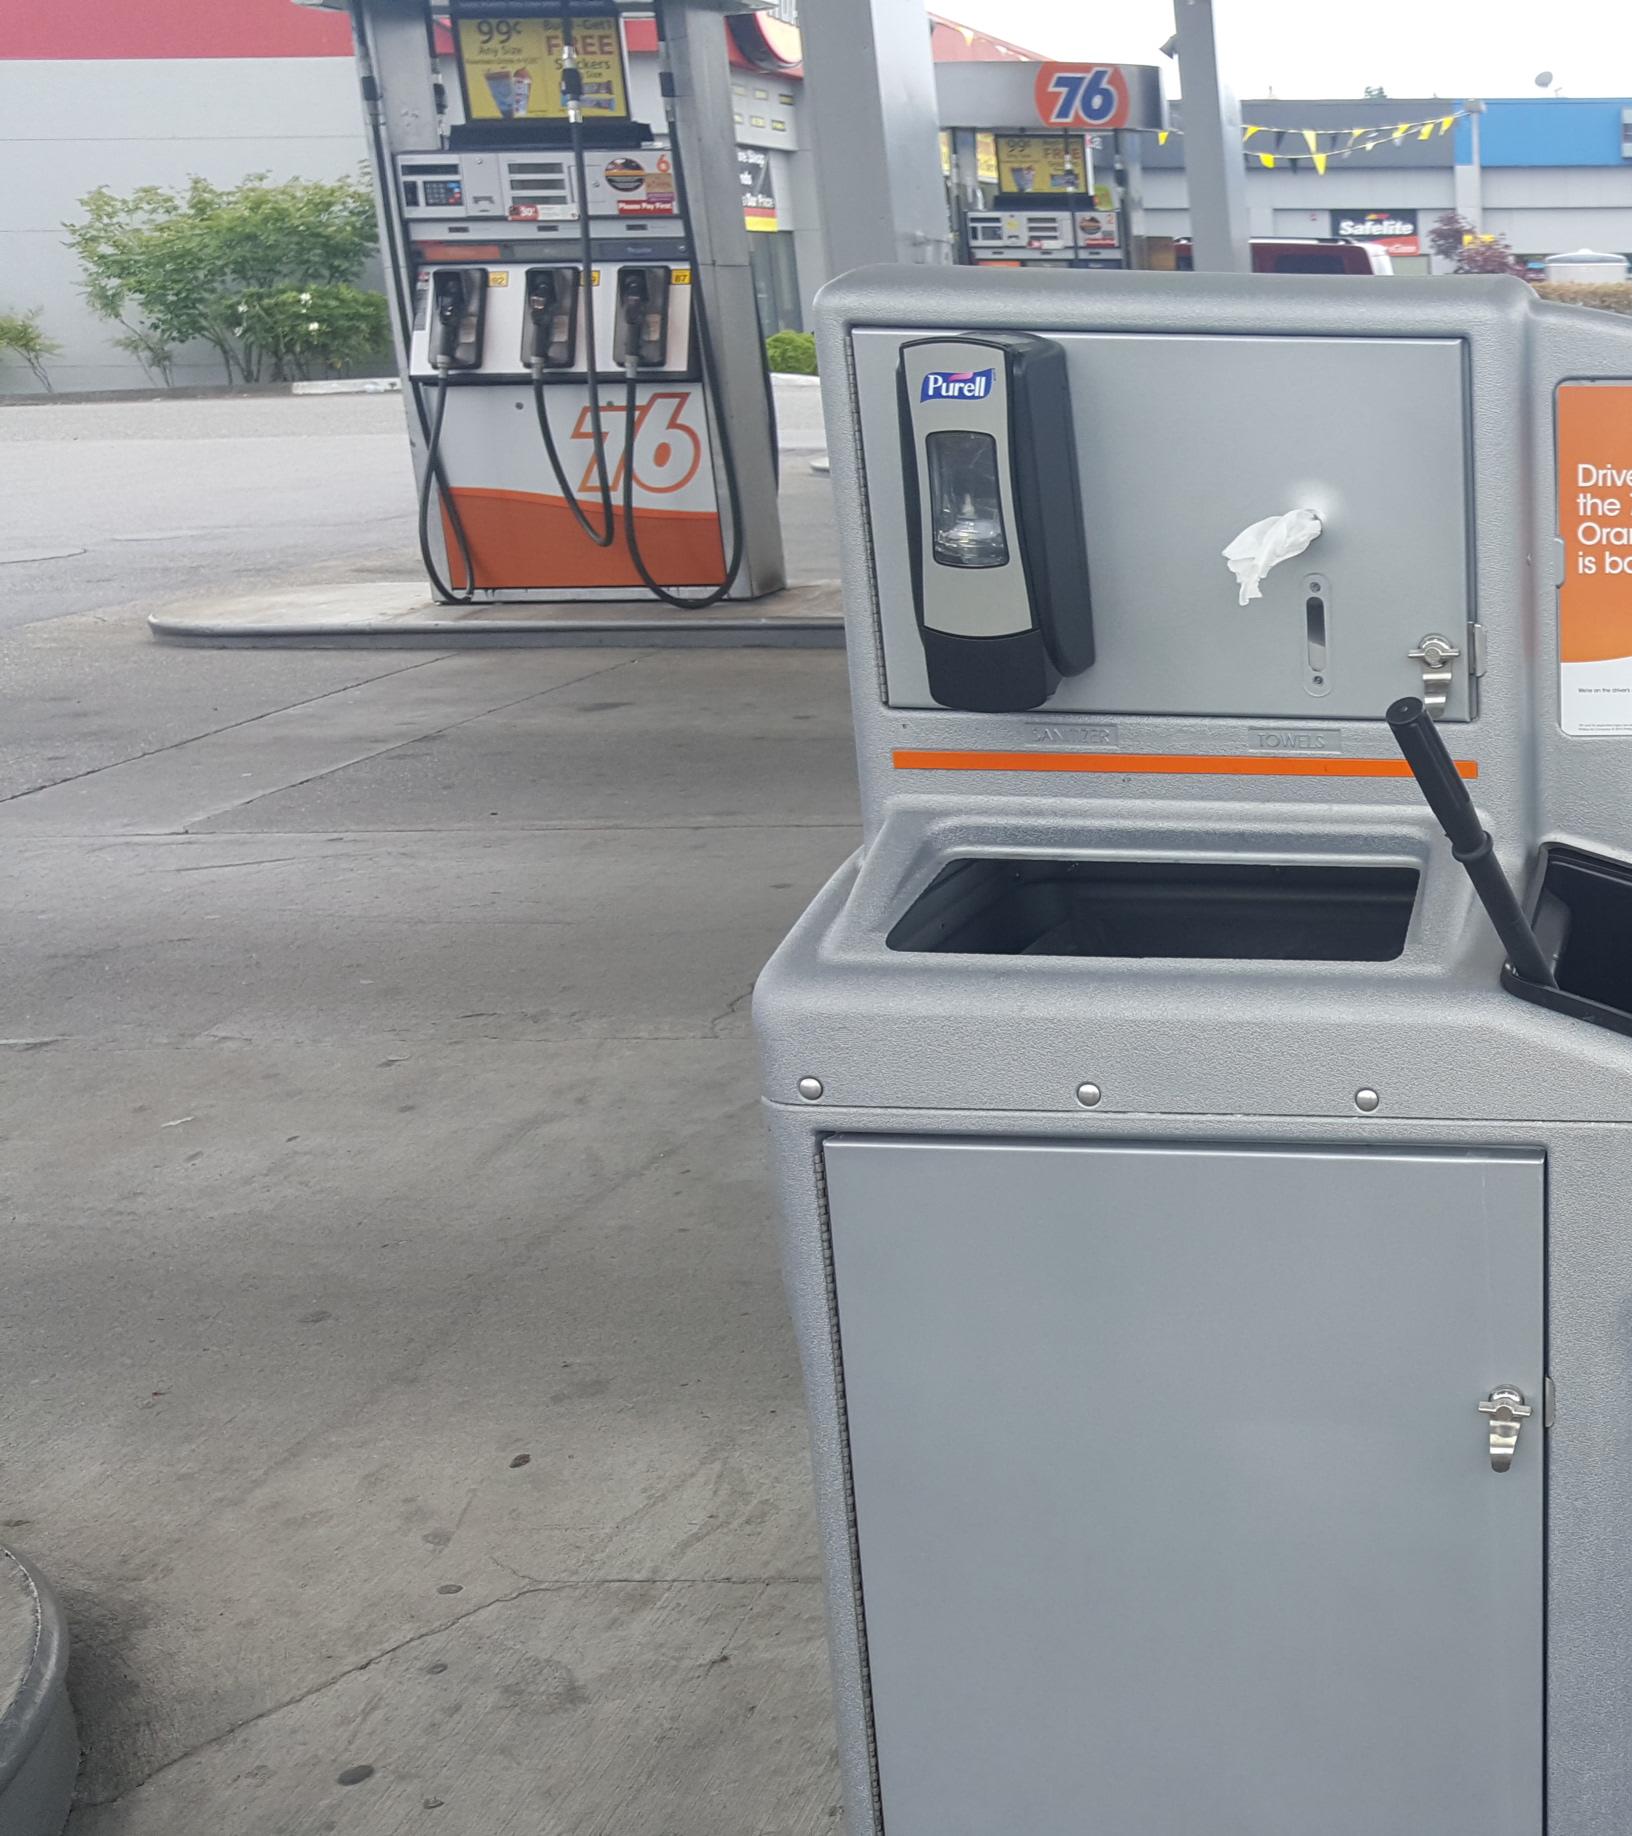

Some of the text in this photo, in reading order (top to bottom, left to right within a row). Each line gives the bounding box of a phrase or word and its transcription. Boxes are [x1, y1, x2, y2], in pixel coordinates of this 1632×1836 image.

[1047, 67, 1116, 125] 76
[656, 153, 671, 173] 6
[1339, 219, 1414, 235] Safelite
[927, 374, 987, 397] Purell
[570, 391, 701, 494] 76
[1576, 493, 1621, 516] the
[1578, 551, 1597, 574] is
[1256, 732, 1326, 749] TOWELS
